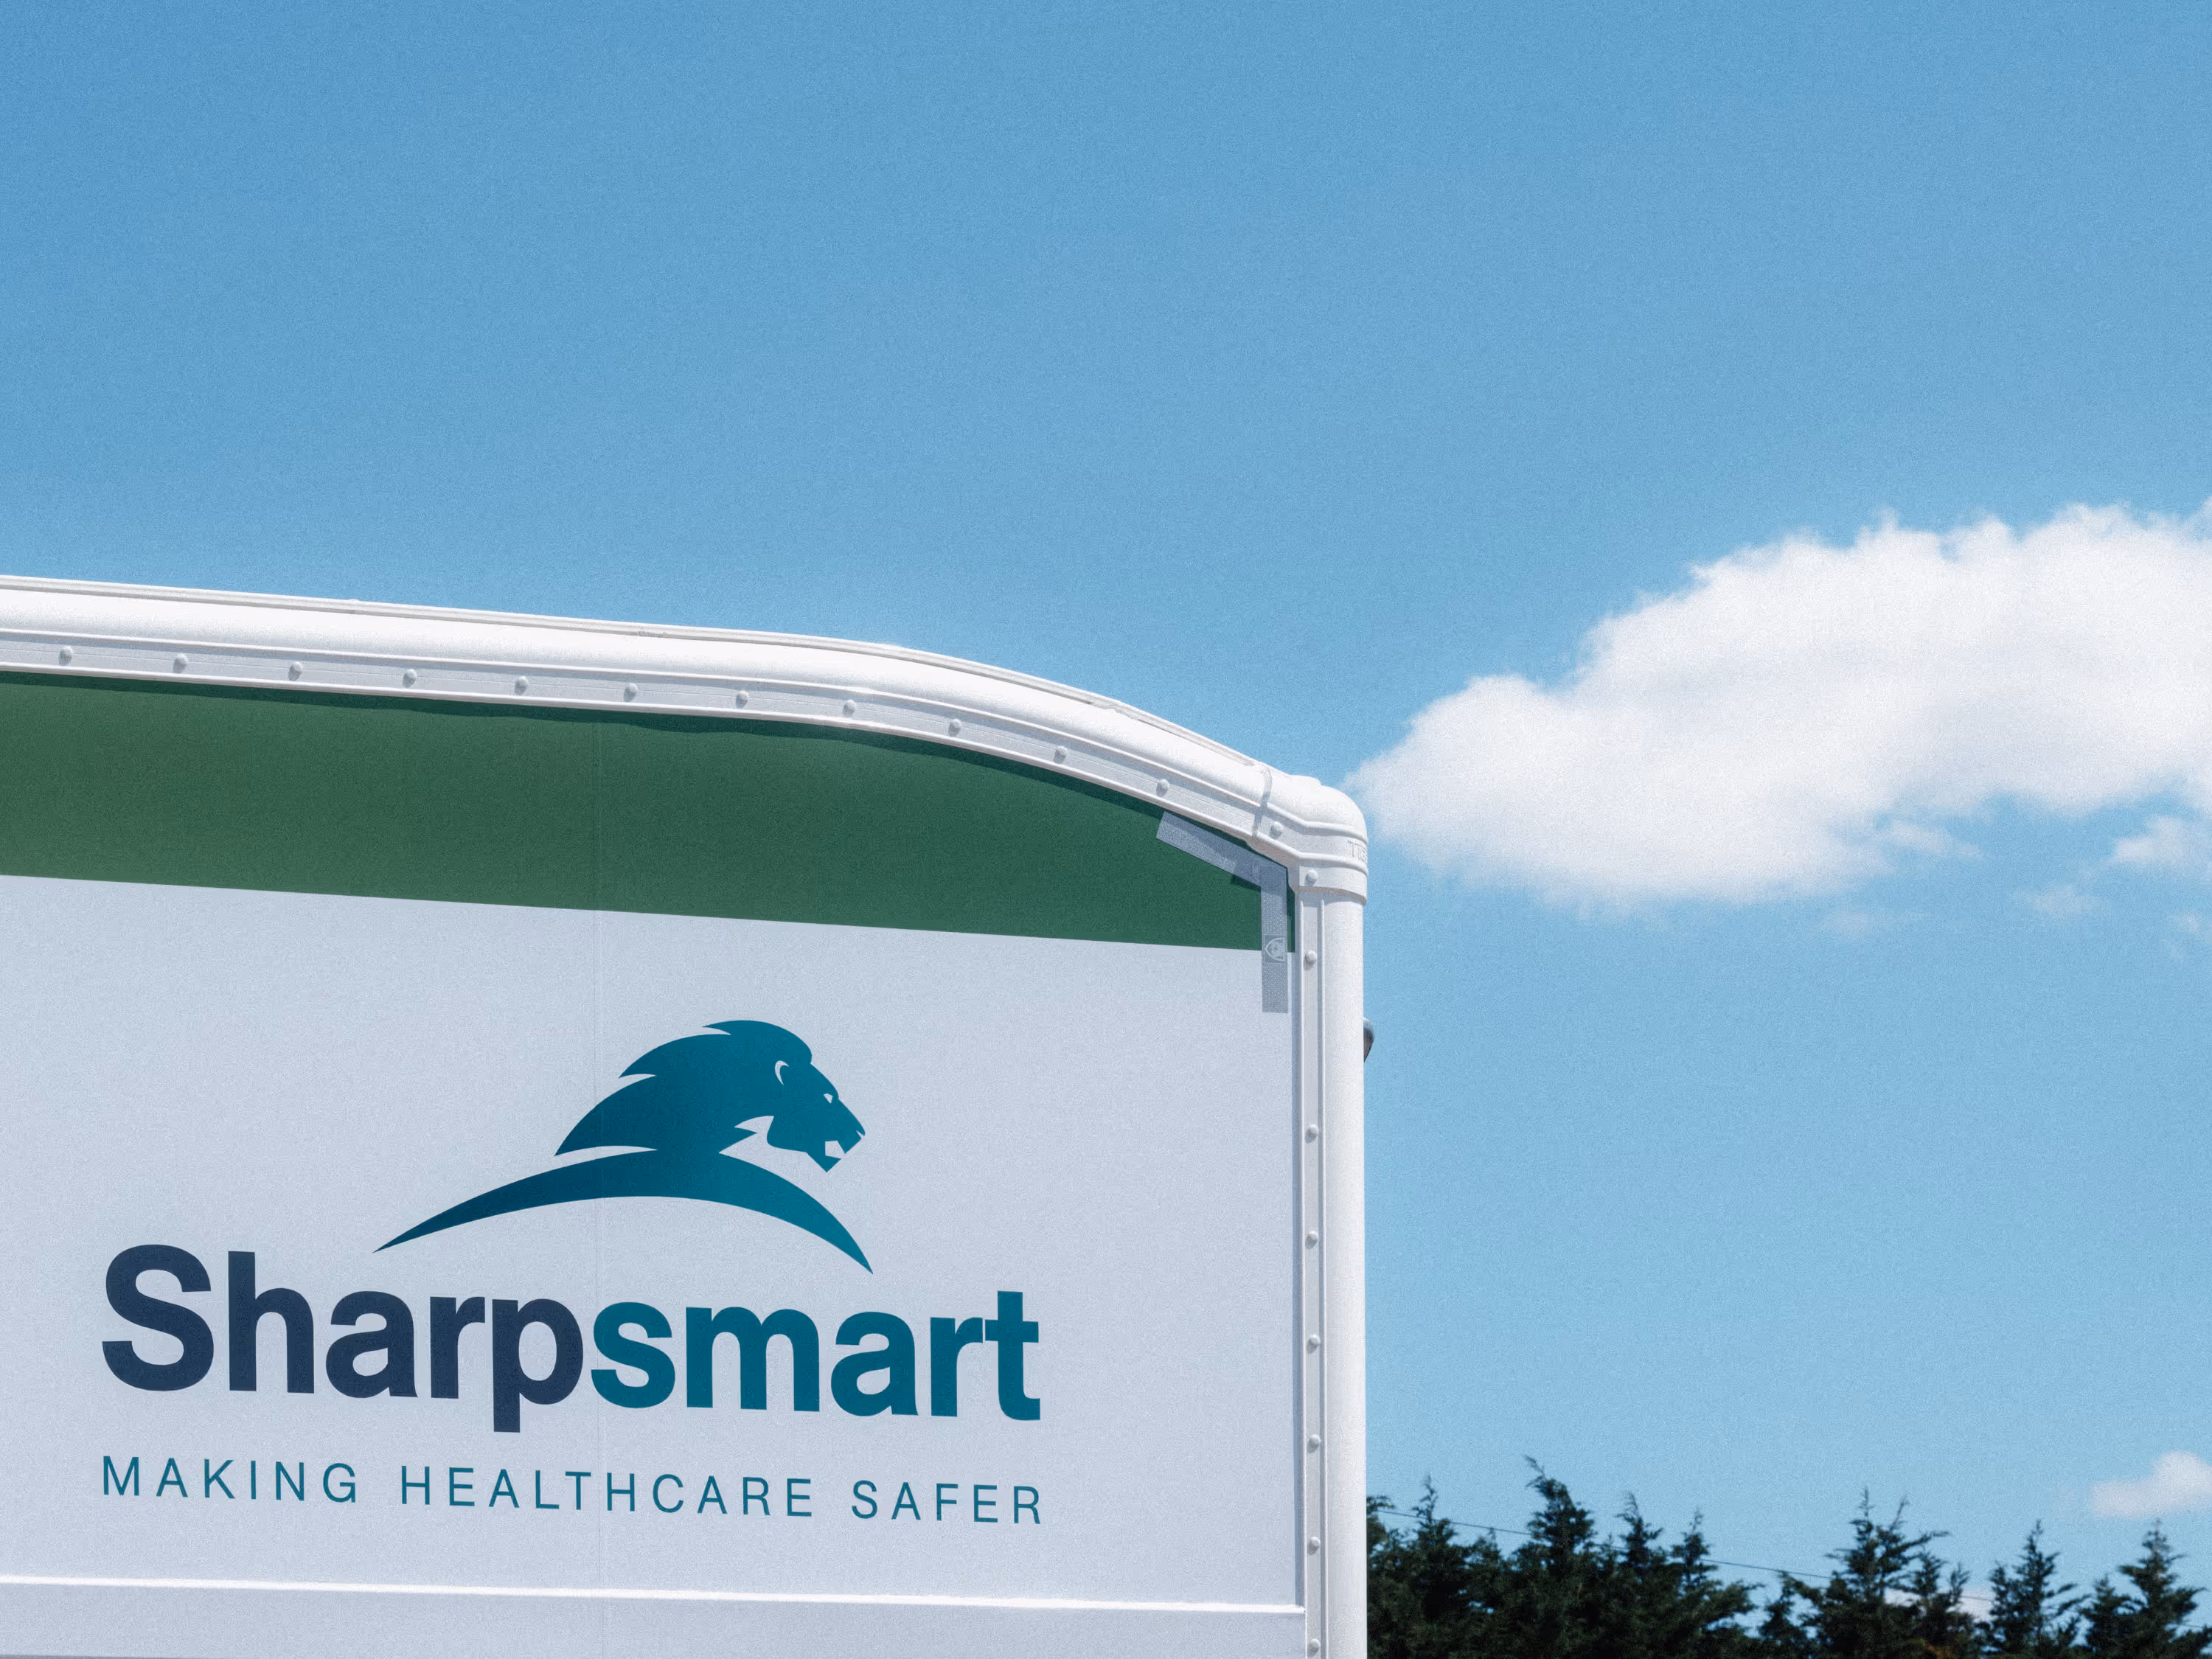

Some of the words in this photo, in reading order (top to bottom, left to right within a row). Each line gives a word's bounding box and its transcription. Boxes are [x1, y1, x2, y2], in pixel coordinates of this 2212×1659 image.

[101, 1244, 1042, 1433] Sharpsmart
[102, 1455, 357, 1503] MAKING
[400, 1465, 813, 1518] HEALTHCARE
[852, 1480, 1041, 1525] SAFER
